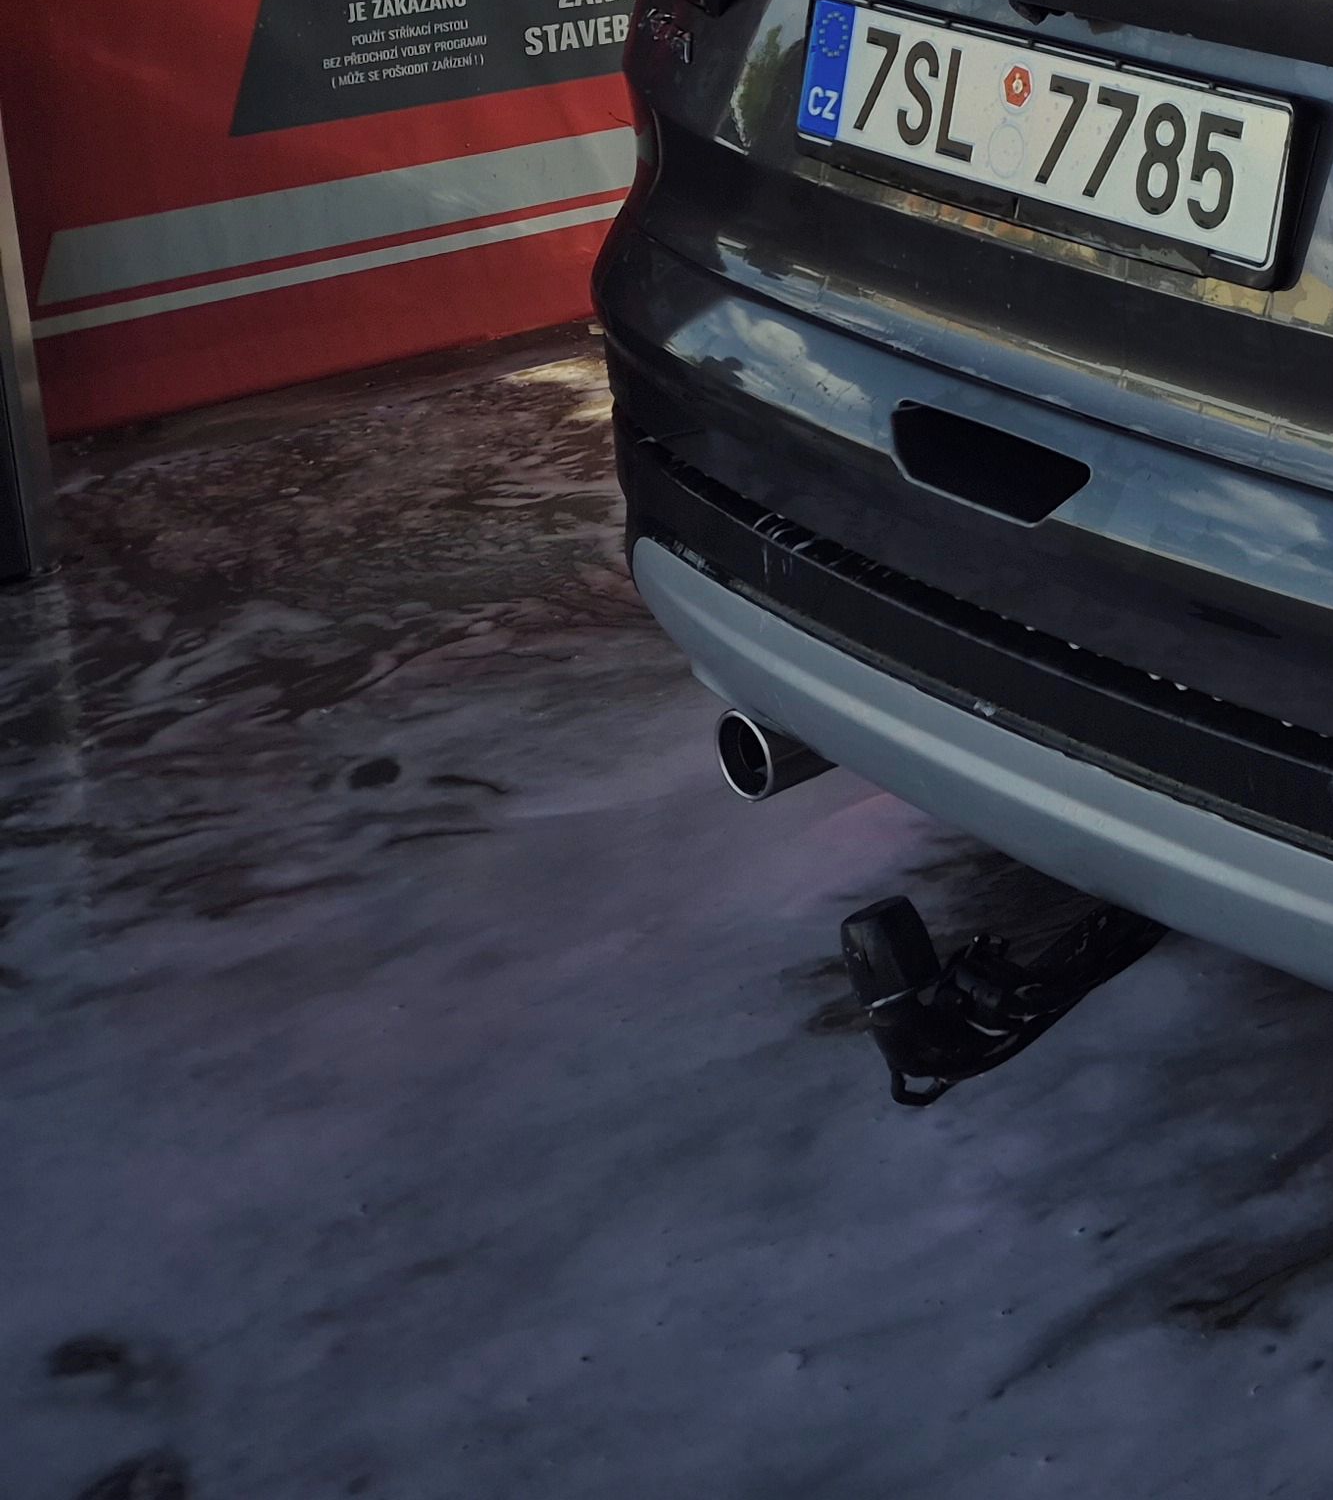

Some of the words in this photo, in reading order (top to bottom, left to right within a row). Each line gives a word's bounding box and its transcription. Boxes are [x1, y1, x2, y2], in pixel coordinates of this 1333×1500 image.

[347, 1, 368, 24] JE
[351, 28, 386, 46] POUŽÍT
[388, 21, 431, 41] STŘÍKACÍ
[434, 18, 470, 35] PISTOLI
[524, 12, 634, 56] STAVEB
[322, 56, 342, 70] BEZ
[344, 45, 399, 68] PŘEDCHOZÍ
[401, 42, 432, 58] VOLBY
[434, 35, 488, 54] PROGRAMU
[338, 71, 366, 87] MŮŽE
[367, 69, 380, 83] SE
[382, 61, 429, 80] POŠKODIT
[806, 84, 840, 122] CZ
[853, 25, 976, 163] 7SL
[1034, 72, 1244, 231] 7785
